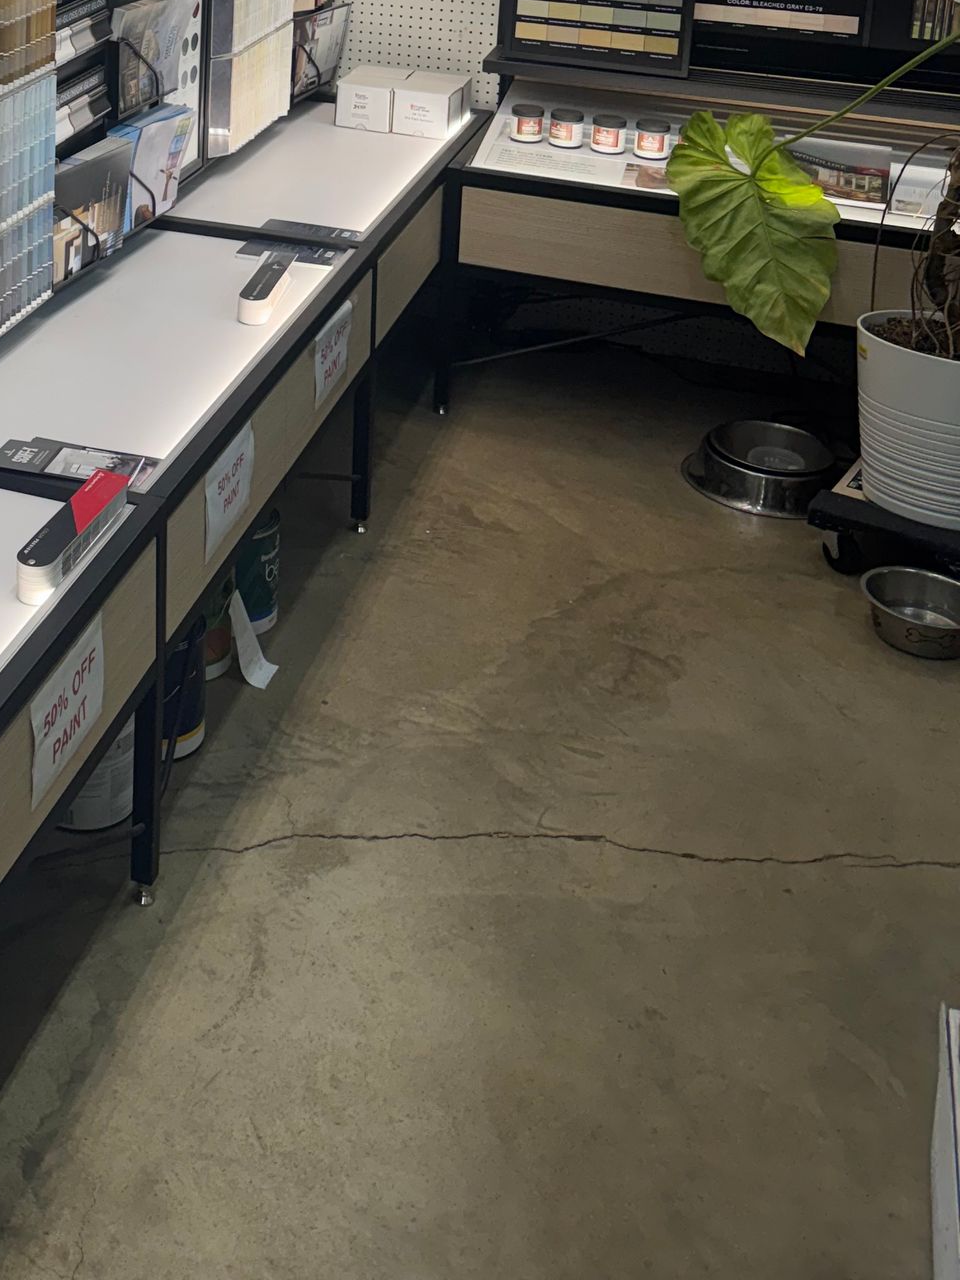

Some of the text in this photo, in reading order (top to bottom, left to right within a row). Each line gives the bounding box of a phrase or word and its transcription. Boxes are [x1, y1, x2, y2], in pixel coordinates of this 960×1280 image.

[752, 0, 785, 9] BLEACHED
[786, 2, 803, 10] GRAY
[217, 452, 245, 496] 50% OFF
[223, 479, 241, 514] PAINT
[43, 647, 96, 738] 50% OFF
[52, 695, 87, 764] PAINT
